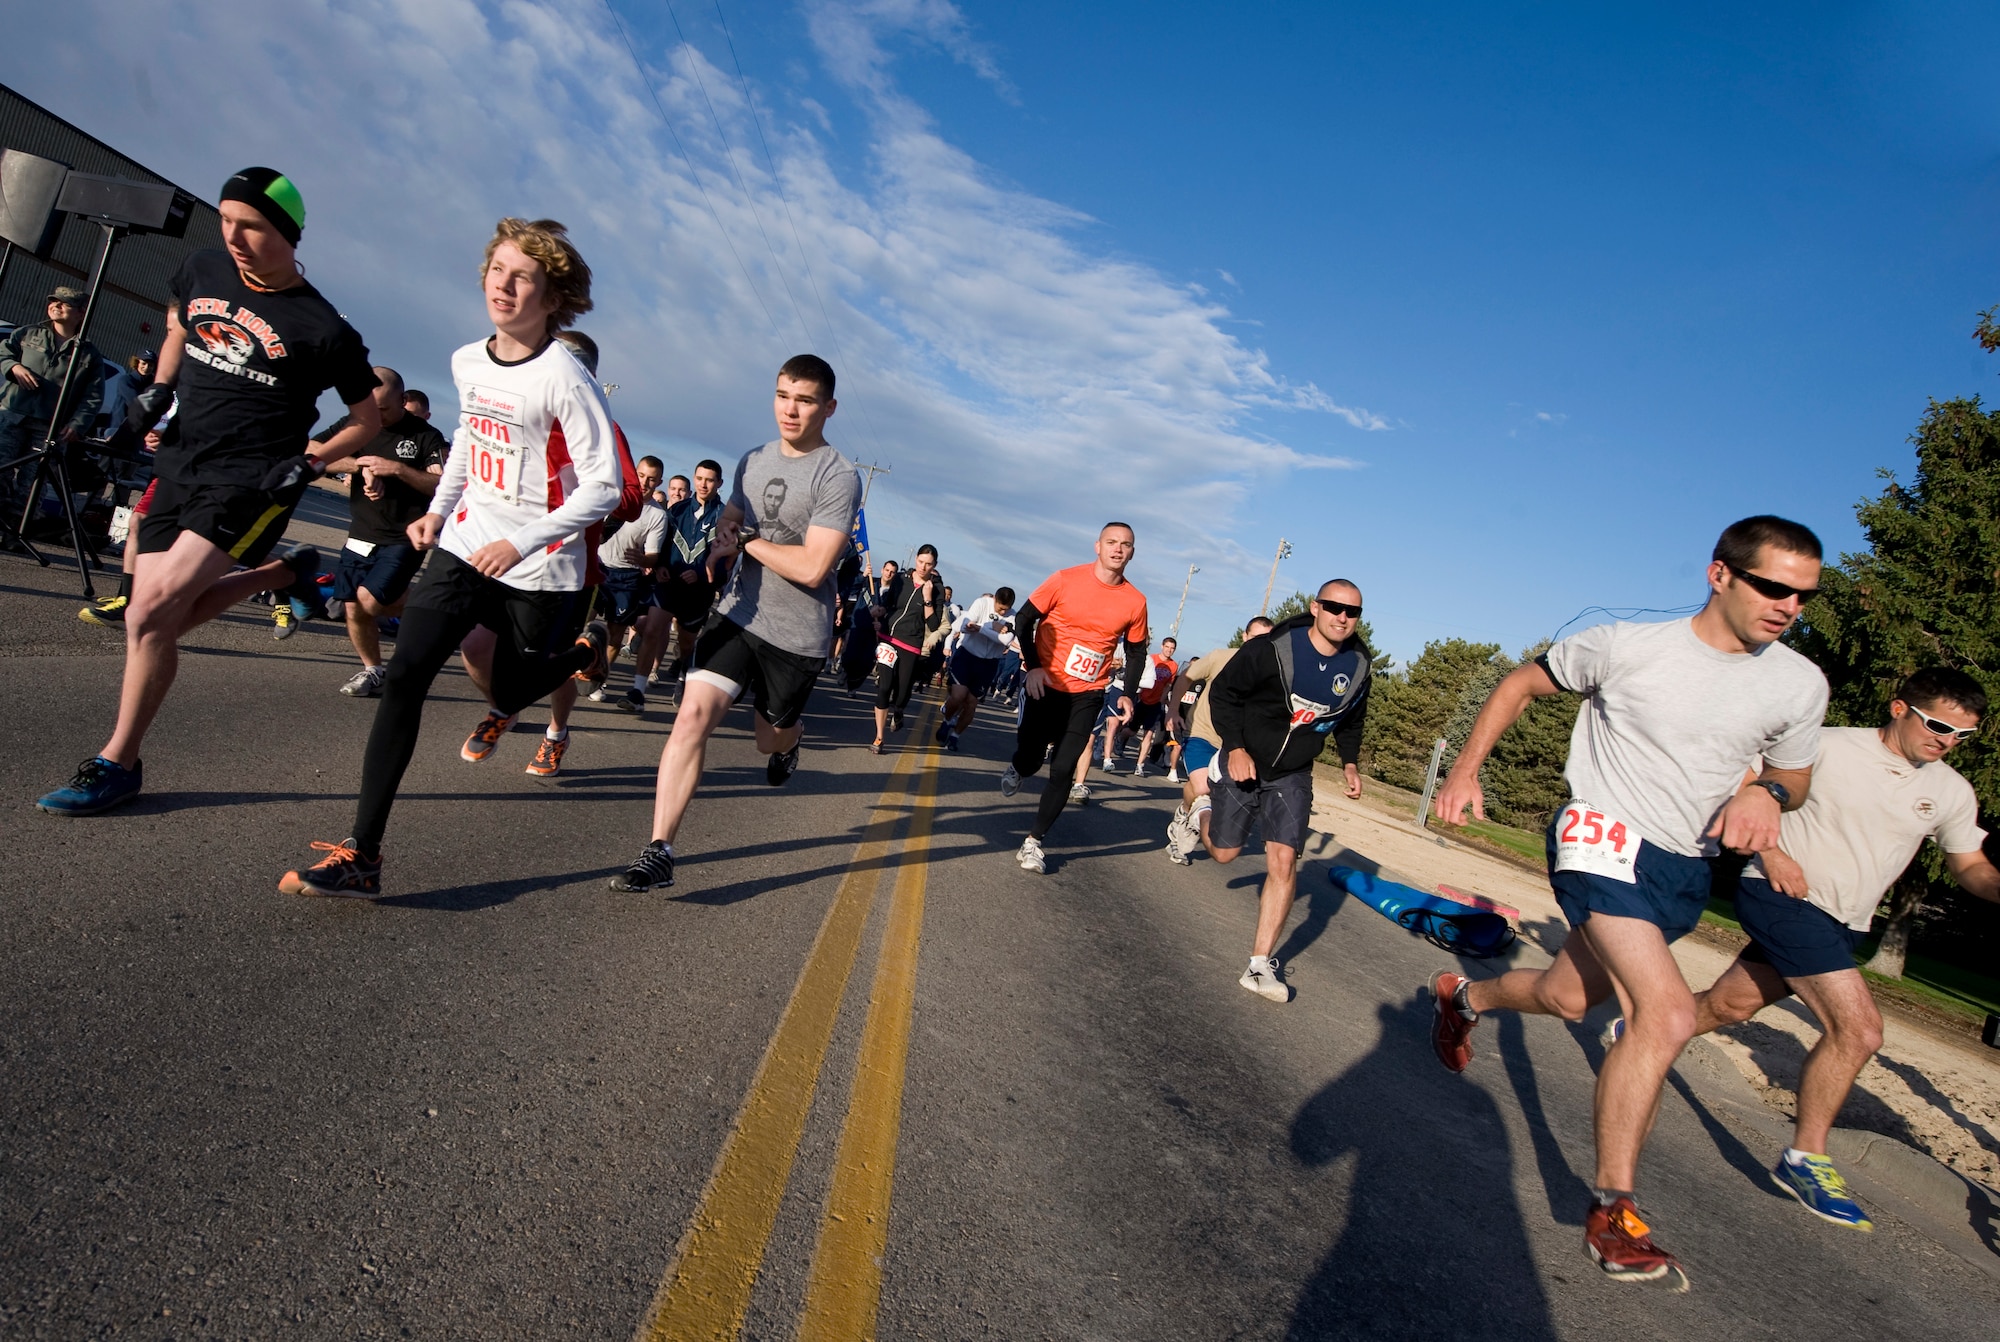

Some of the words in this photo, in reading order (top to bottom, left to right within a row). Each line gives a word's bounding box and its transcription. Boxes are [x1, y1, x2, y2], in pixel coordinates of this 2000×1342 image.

[187, 298, 232, 321] MTN.
[232, 306, 288, 359] HOME
[211, 357, 278, 386] COUNTRY
[492, 399, 515, 411] Locker
[492, 442, 504, 453] Day
[505, 447, 516, 457] 5K
[471, 445, 505, 490] 101
[875, 647, 895, 663] 279
[1070, 653, 1100, 677] 295
[1561, 809, 1627, 853] 254
